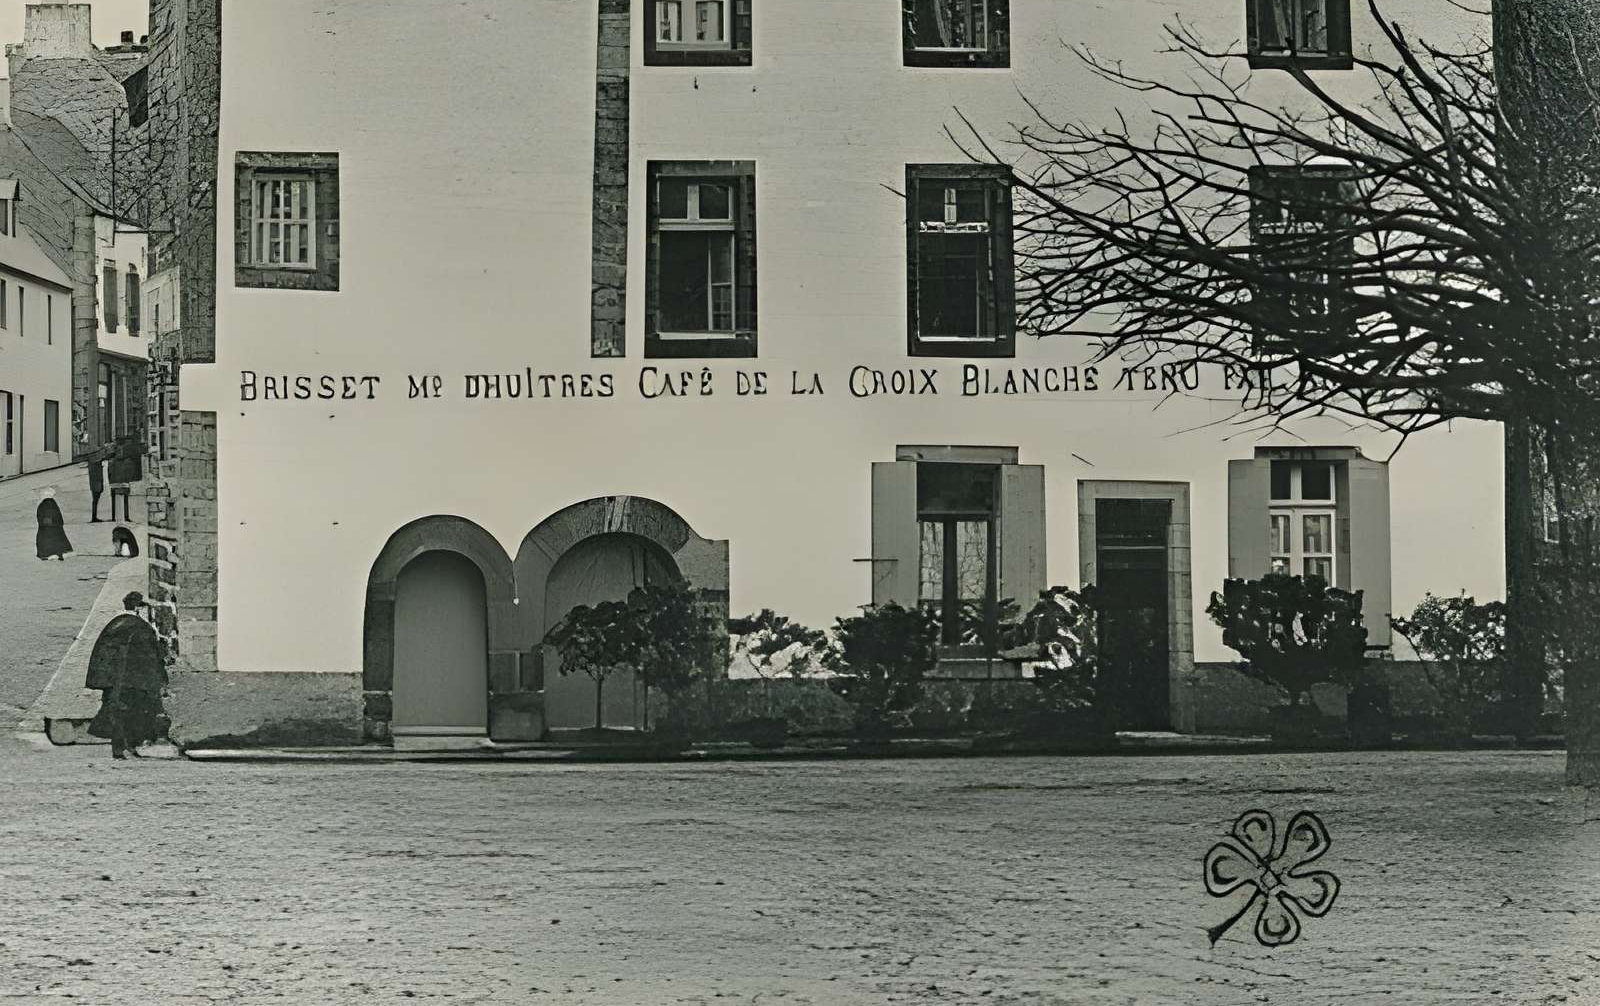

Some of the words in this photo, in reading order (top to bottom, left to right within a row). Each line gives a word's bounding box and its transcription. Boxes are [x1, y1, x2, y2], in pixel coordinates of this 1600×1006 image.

[240, 370, 381, 401] BRISSET
[736, 370, 768, 395] DE
[791, 370, 824, 395] LA
[849, 365, 938, 397] CROIX
[962, 364, 1099, 396] BLANCHE
